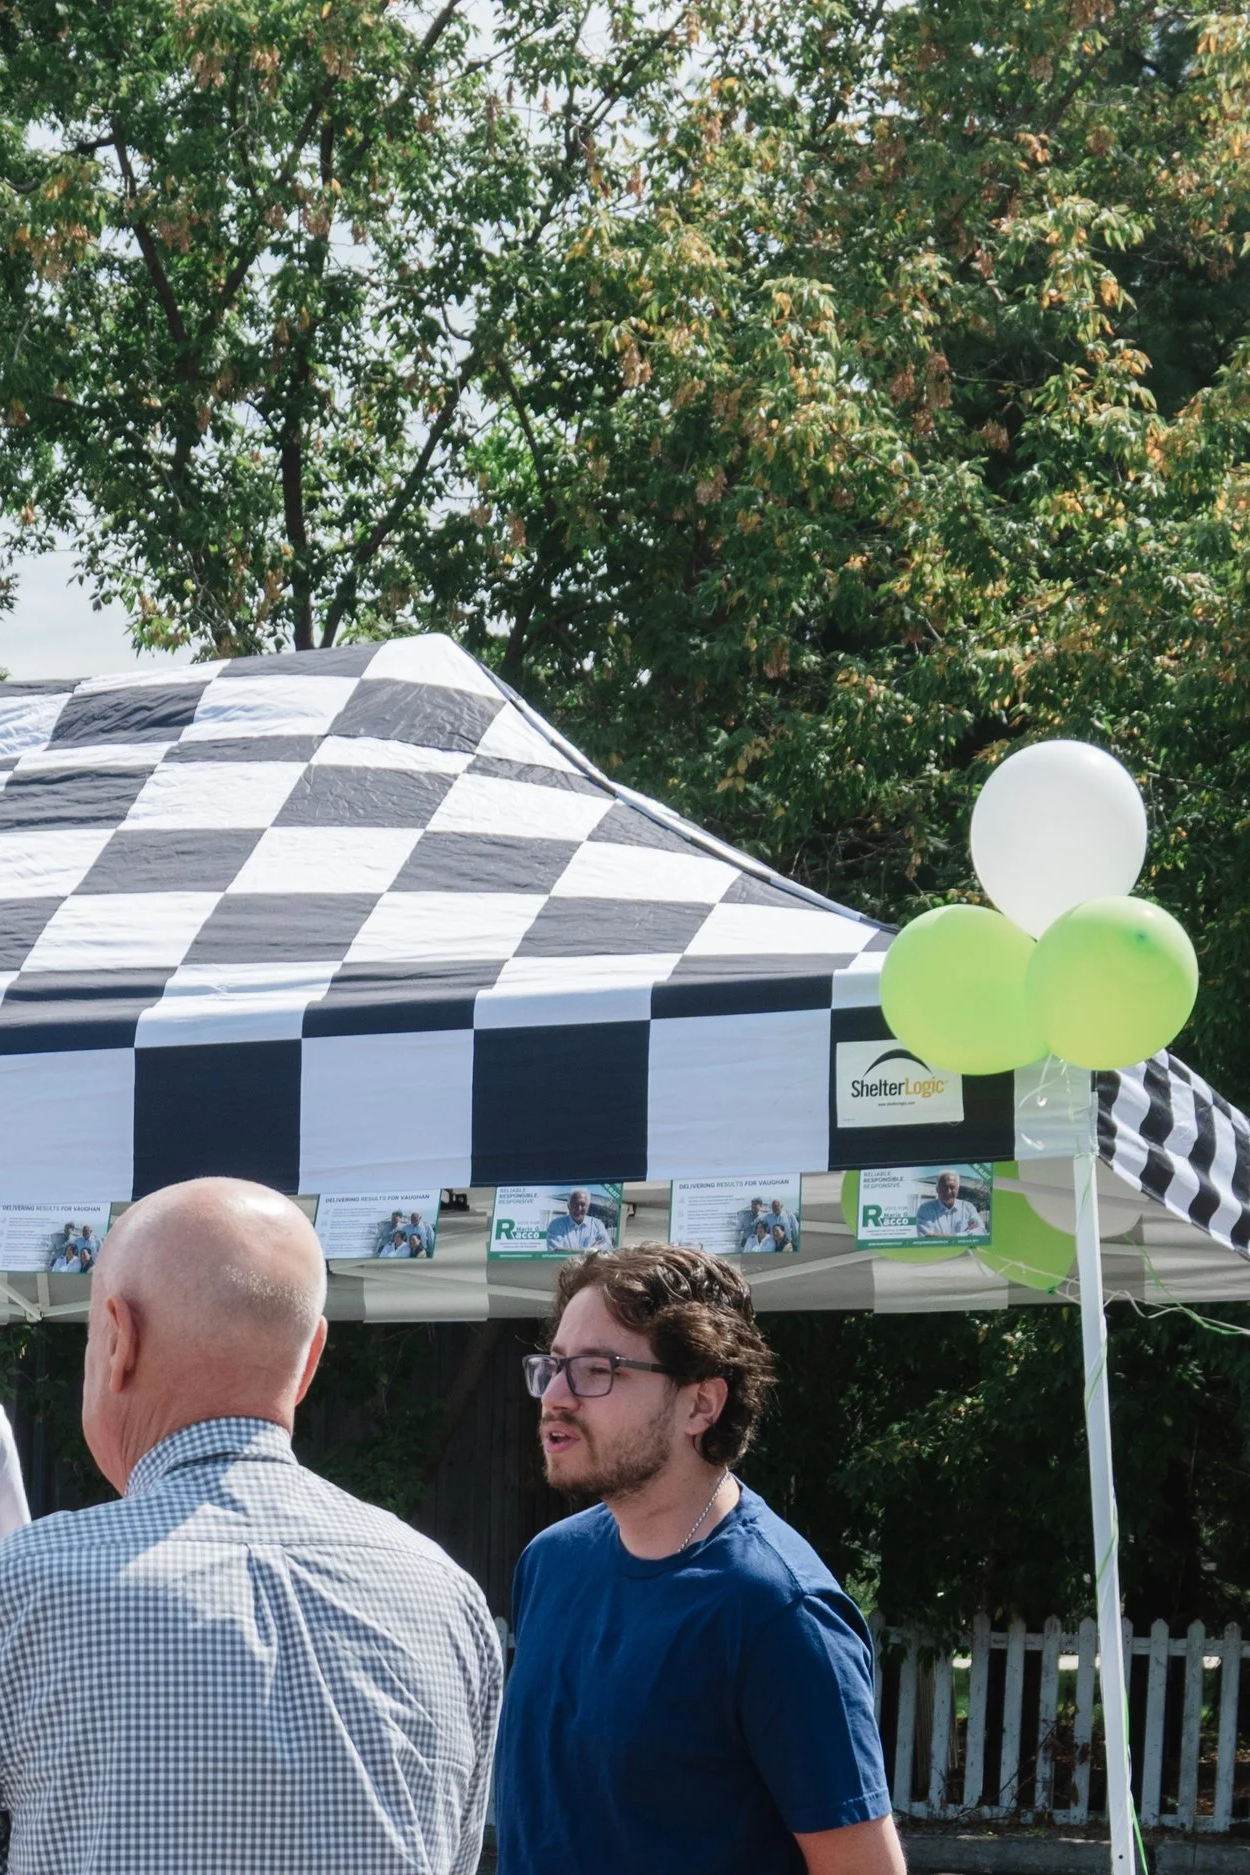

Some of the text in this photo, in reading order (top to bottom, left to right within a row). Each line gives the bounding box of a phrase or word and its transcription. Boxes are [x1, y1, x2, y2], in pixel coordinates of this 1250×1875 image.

[851, 1076, 944, 1098] ShelterLogic
[679, 1181, 715, 1189] DELIVERING
[716, 1180, 744, 1188] RESULTS
